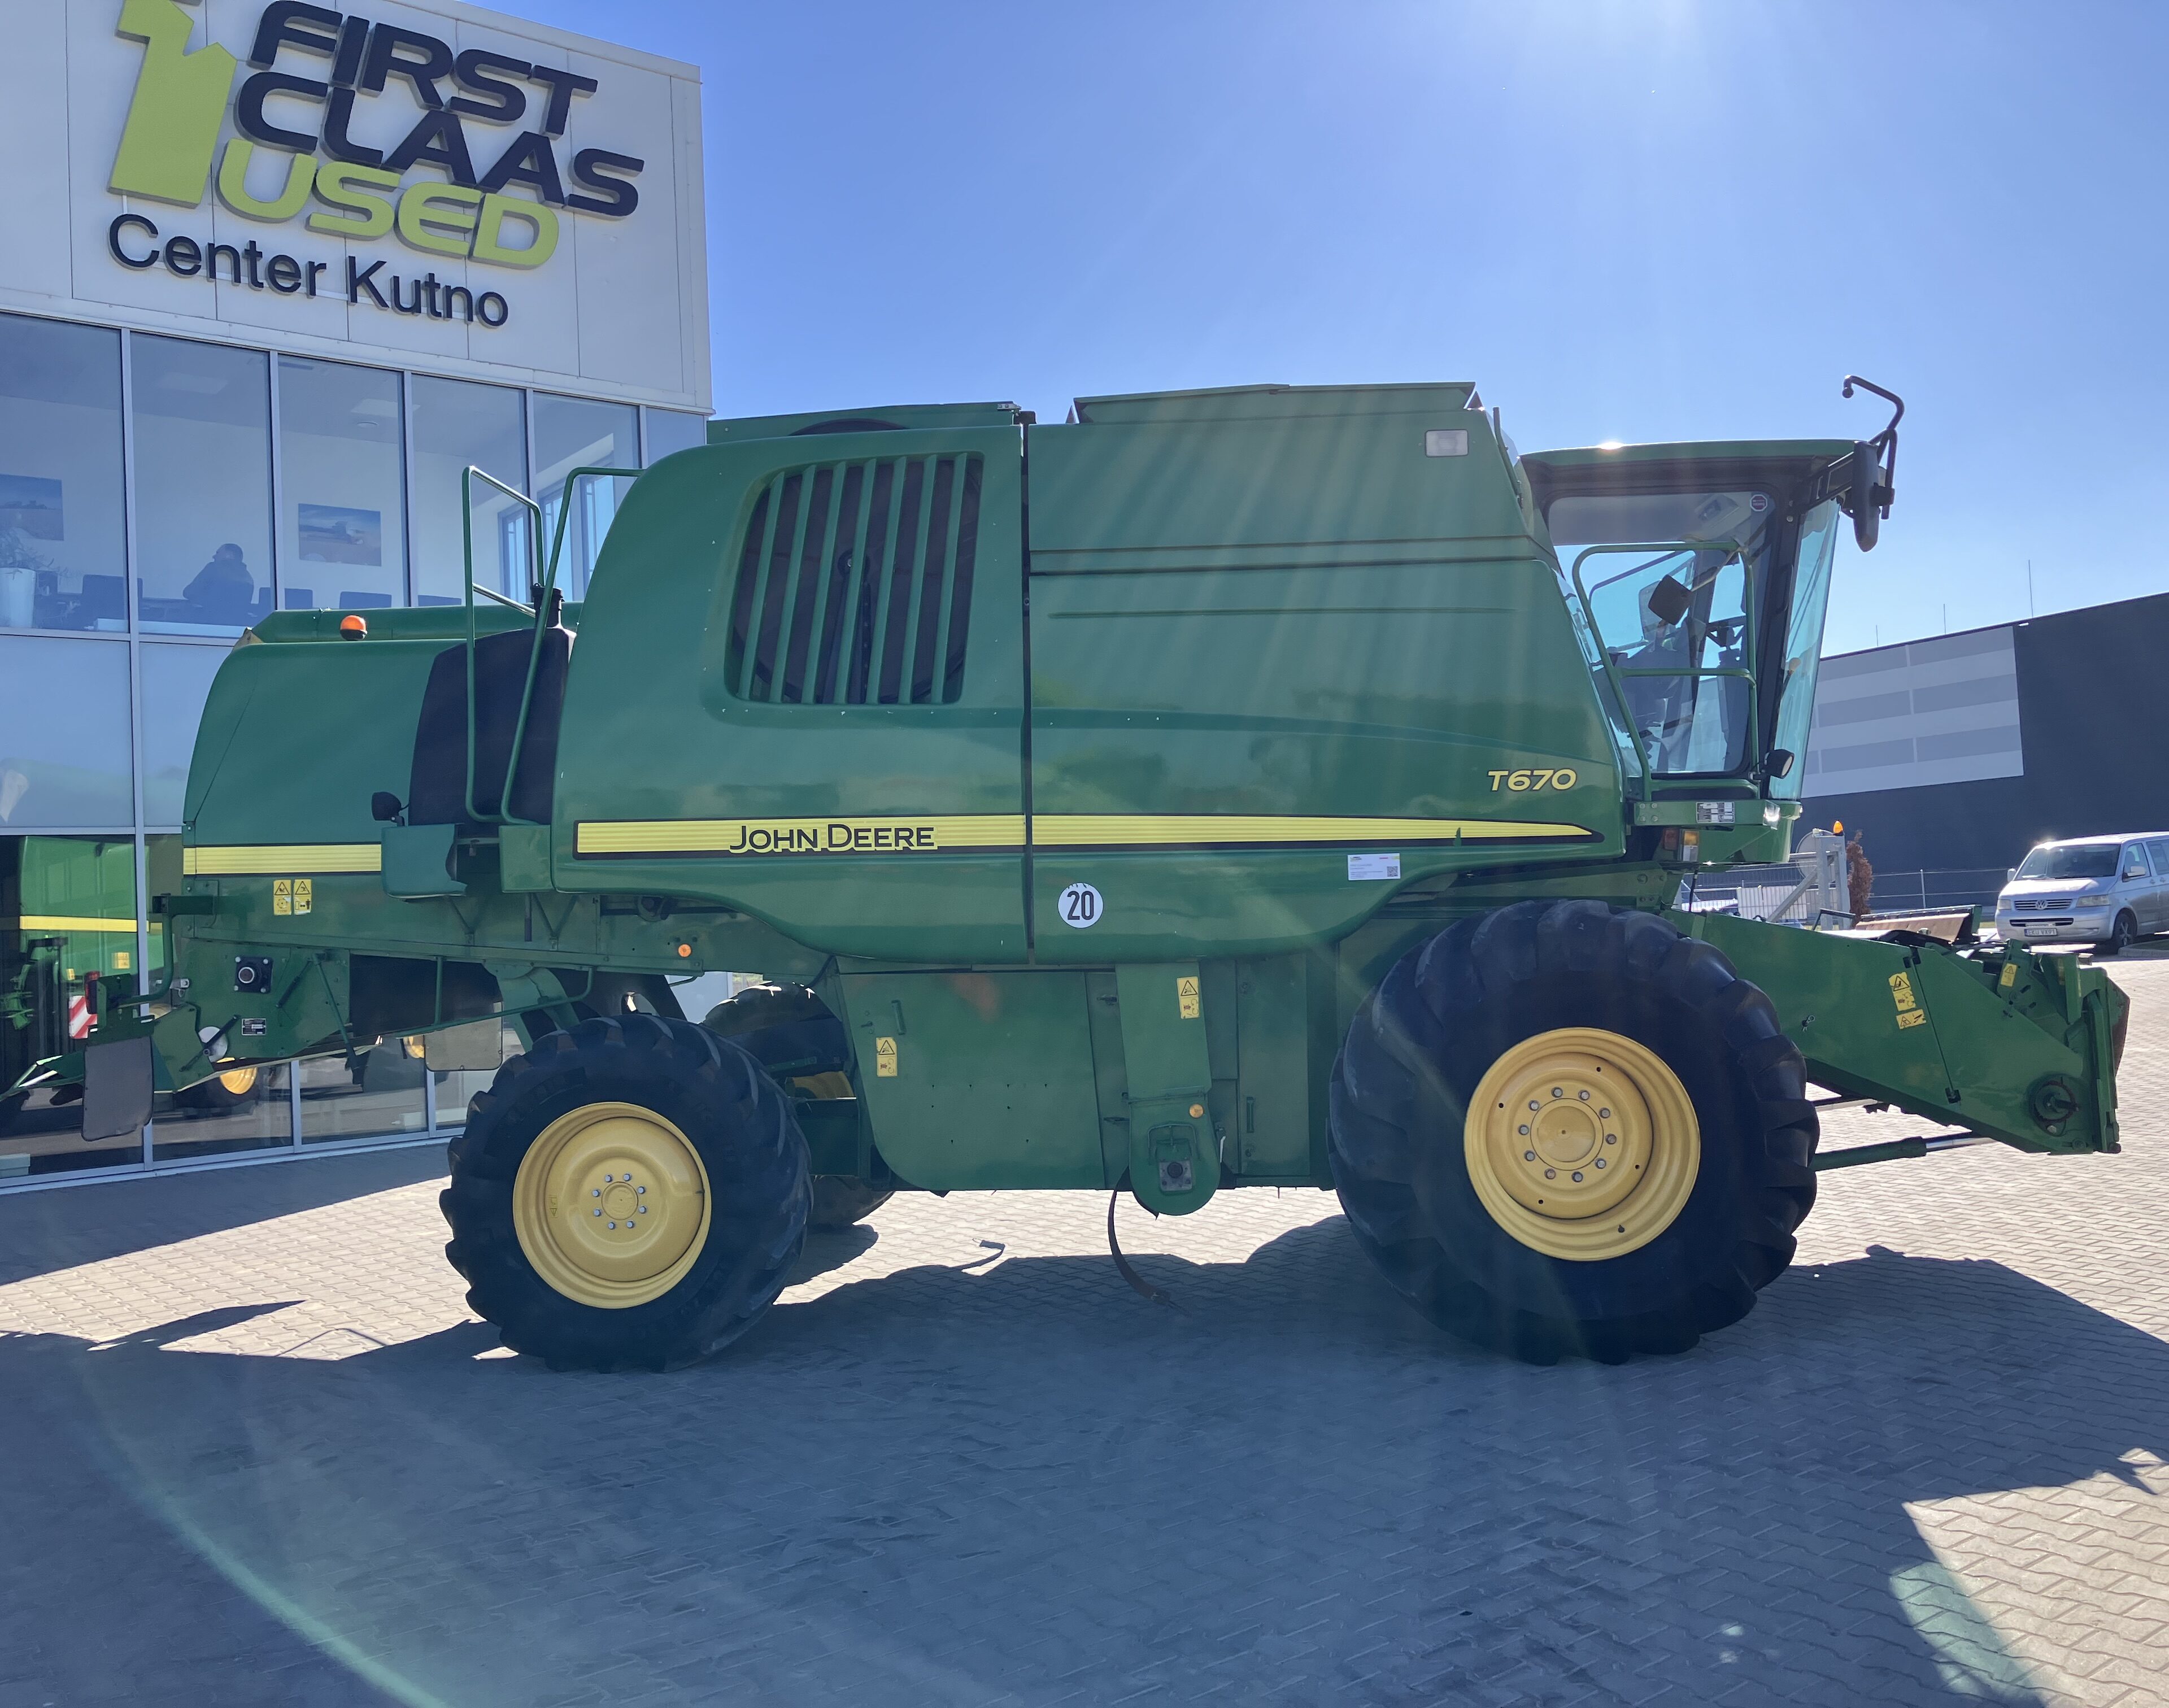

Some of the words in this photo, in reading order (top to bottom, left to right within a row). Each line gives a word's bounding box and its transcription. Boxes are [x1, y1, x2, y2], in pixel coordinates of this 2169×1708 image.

[250, 0, 598, 137] FIRST
[234, 72, 644, 216] CLAAS
[217, 139, 559, 268] USED
[109, 213, 326, 297] Center
[347, 255, 508, 328] Kutno
[730, 825, 818, 849] JOHN
[827, 823, 934, 848] DEERE
[1487, 768, 1577, 792] T670
[1067, 891, 1094, 920] 20
